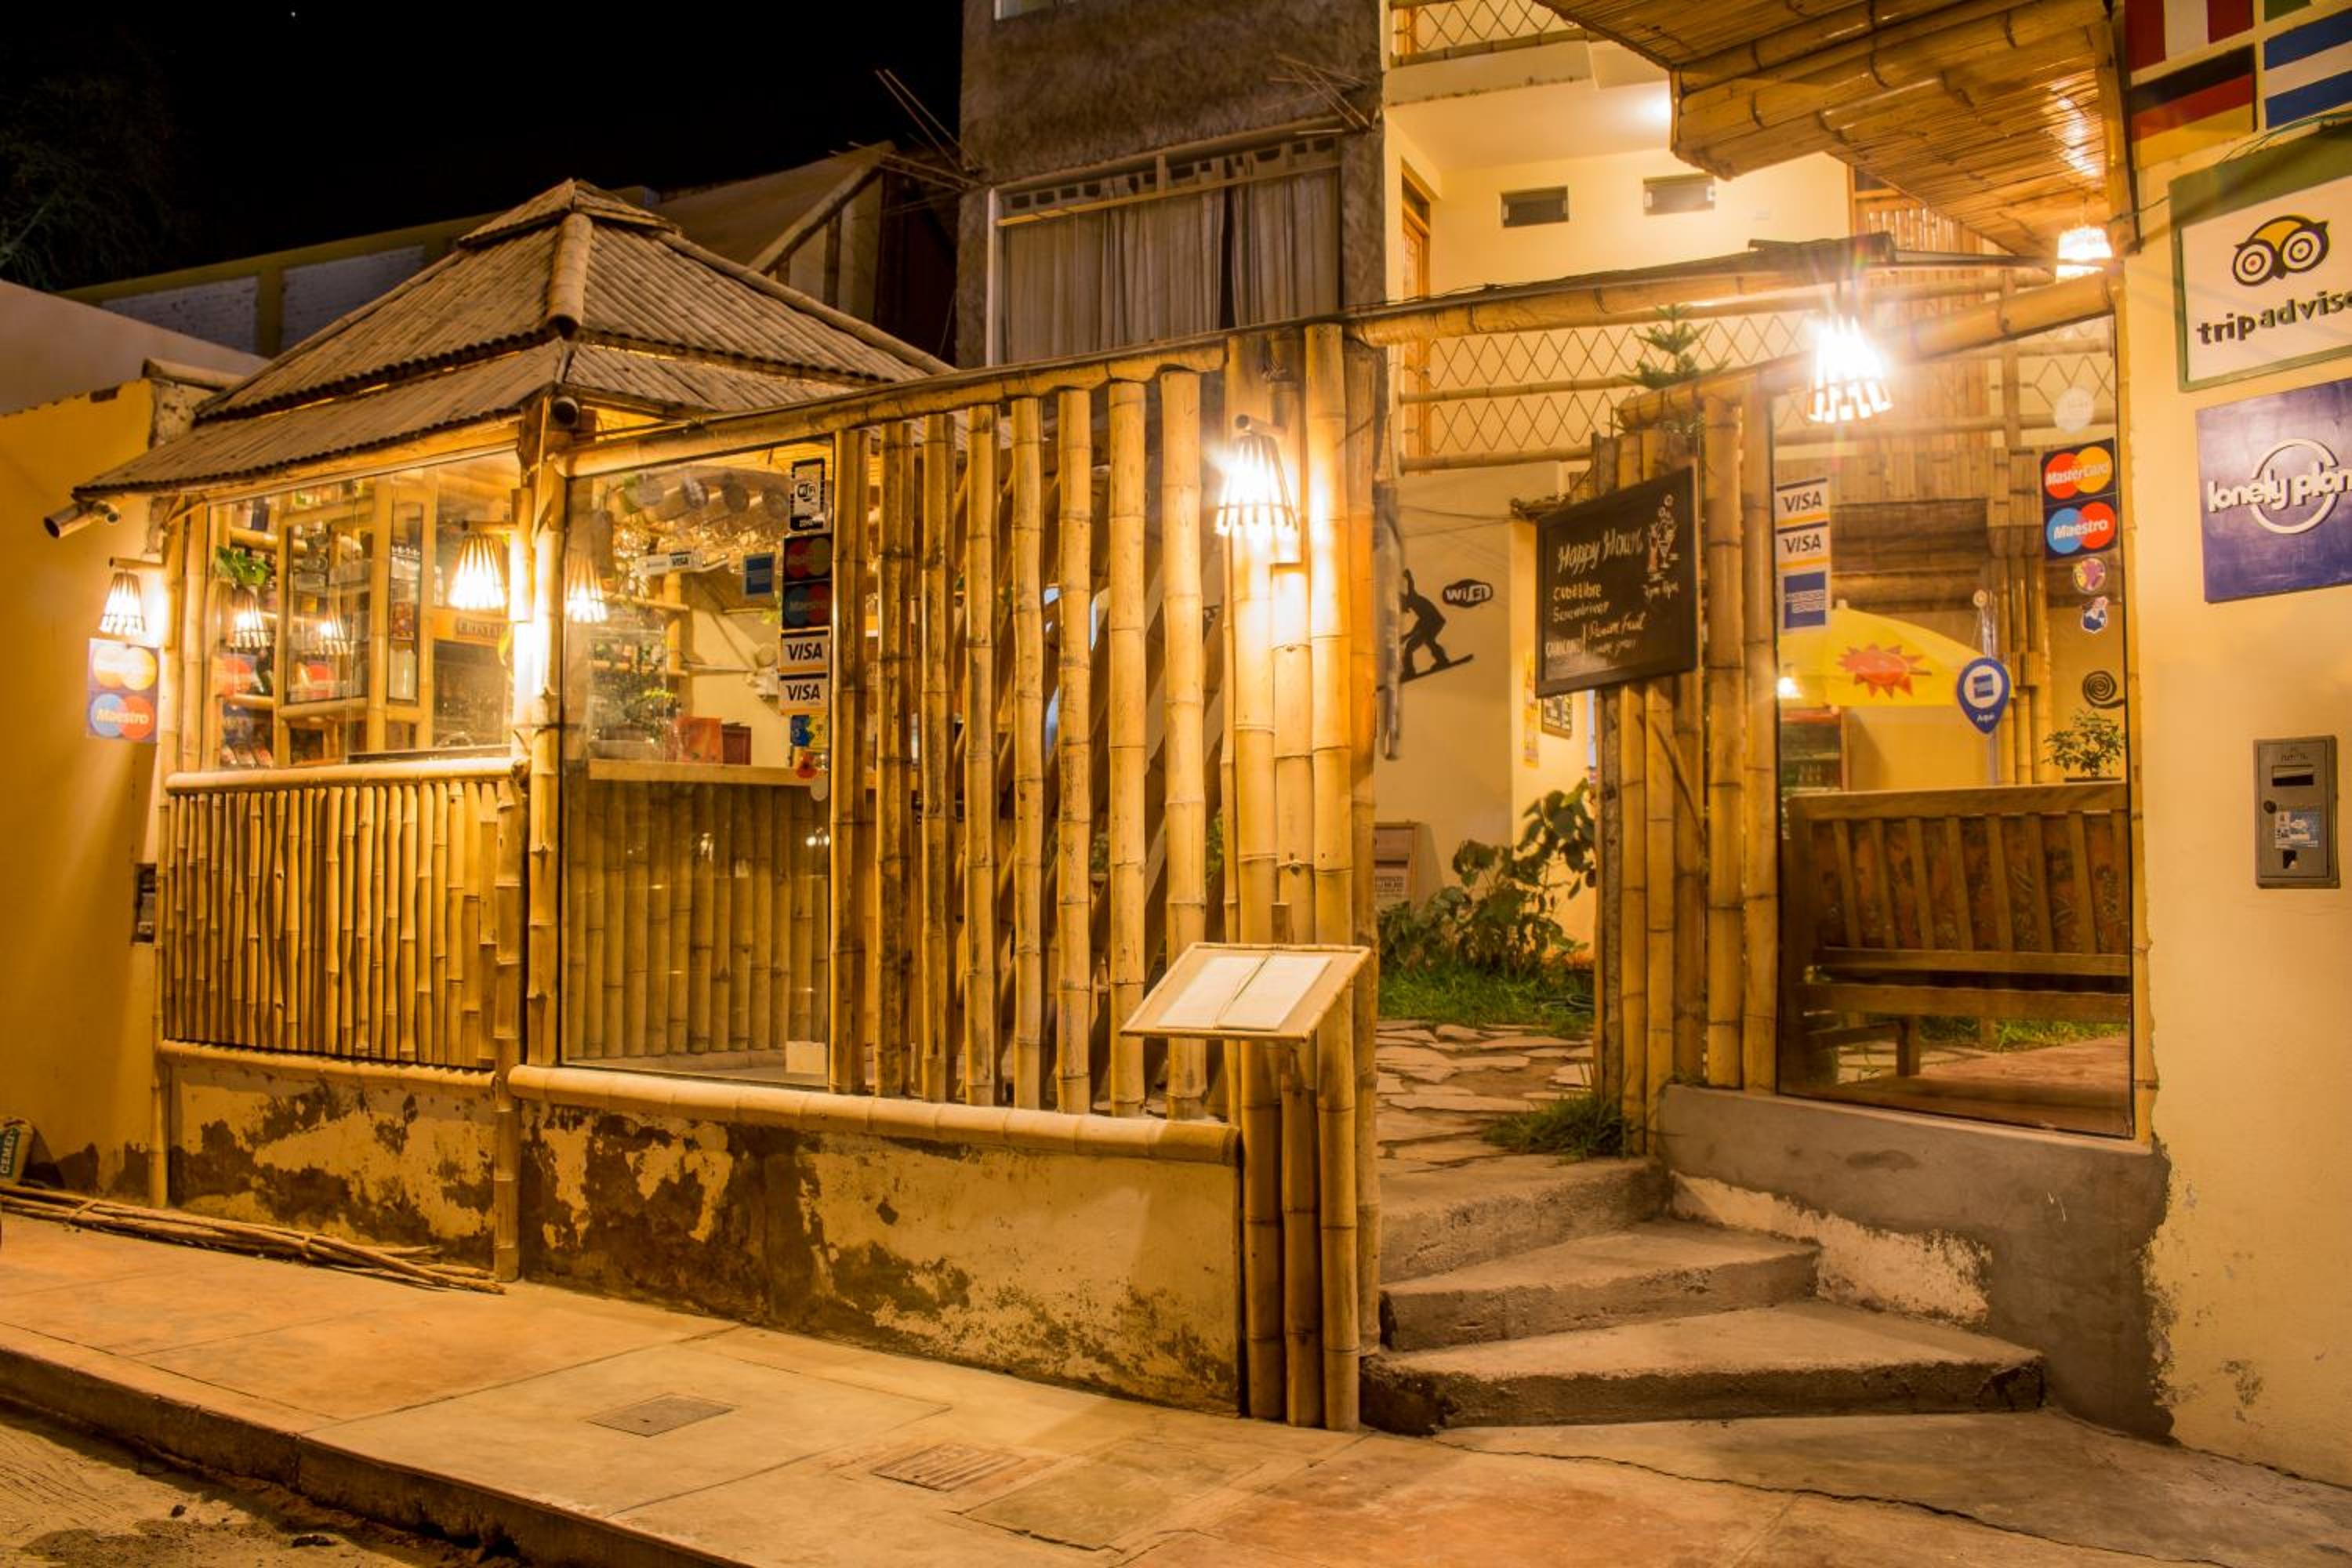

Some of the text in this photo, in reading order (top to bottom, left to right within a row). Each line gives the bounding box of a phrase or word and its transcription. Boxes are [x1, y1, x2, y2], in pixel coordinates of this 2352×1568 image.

[1782, 491, 1822, 512] VISA
[2207, 470, 2290, 513] lonely
[2053, 518, 2108, 539] Maestro
[1782, 534, 1822, 554] VISA
[1557, 540, 1600, 577] Happy
[786, 642, 822, 661] VISA
[786, 684, 821, 702] VISA
[96, 708, 150, 726] Maestro
